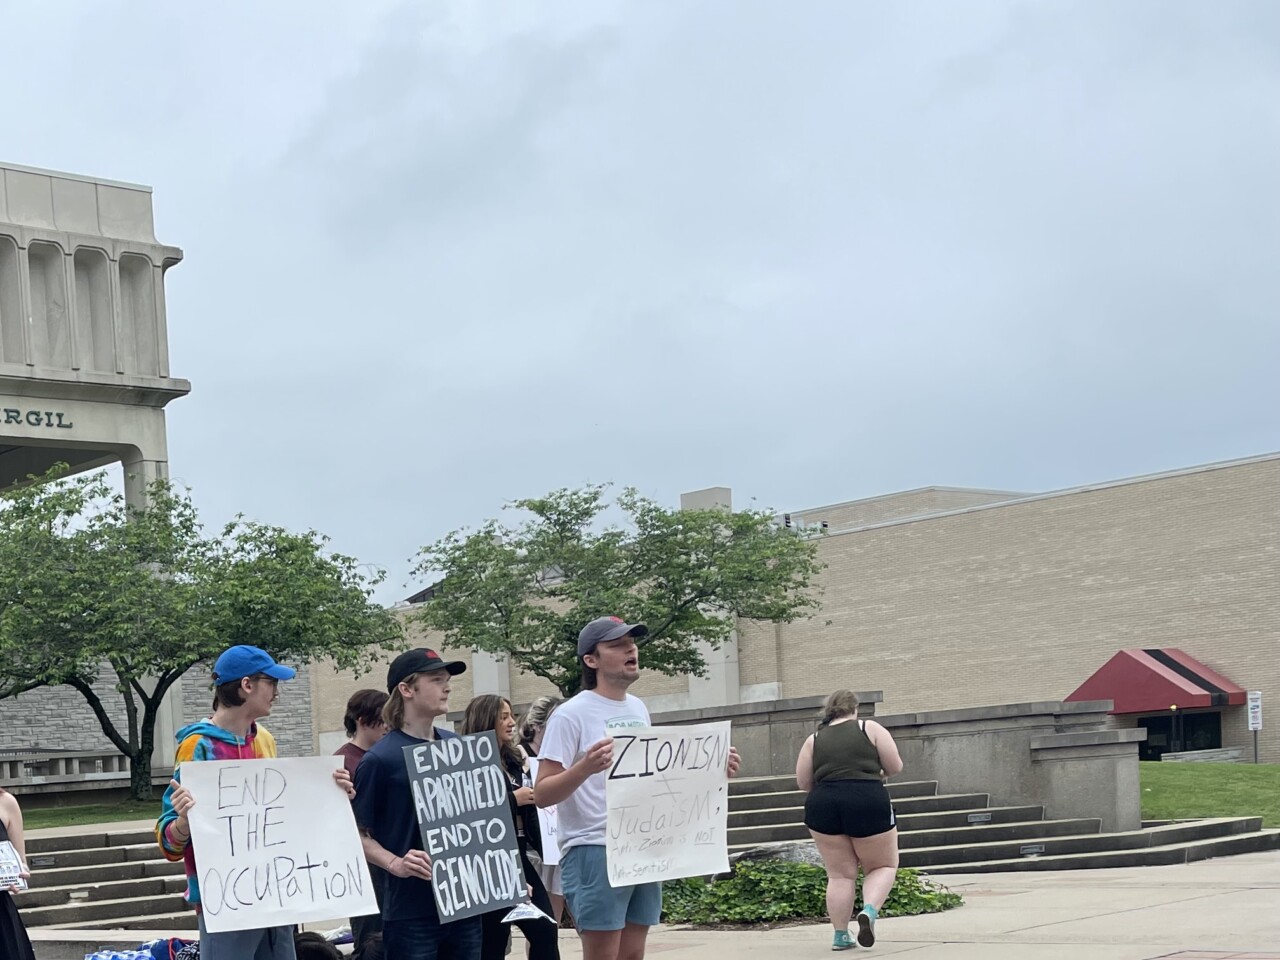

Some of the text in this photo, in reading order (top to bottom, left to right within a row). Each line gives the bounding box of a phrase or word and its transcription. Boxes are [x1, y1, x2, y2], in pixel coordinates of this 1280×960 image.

[412, 736, 493, 774] END TO
[607, 730, 728, 781] ZIONISM
[217, 766, 287, 811] END
[412, 764, 507, 825] APARTHEID
[216, 806, 287, 857] THE
[426, 817, 507, 856] END TO
[431, 849, 528, 917] GENOCIDE
